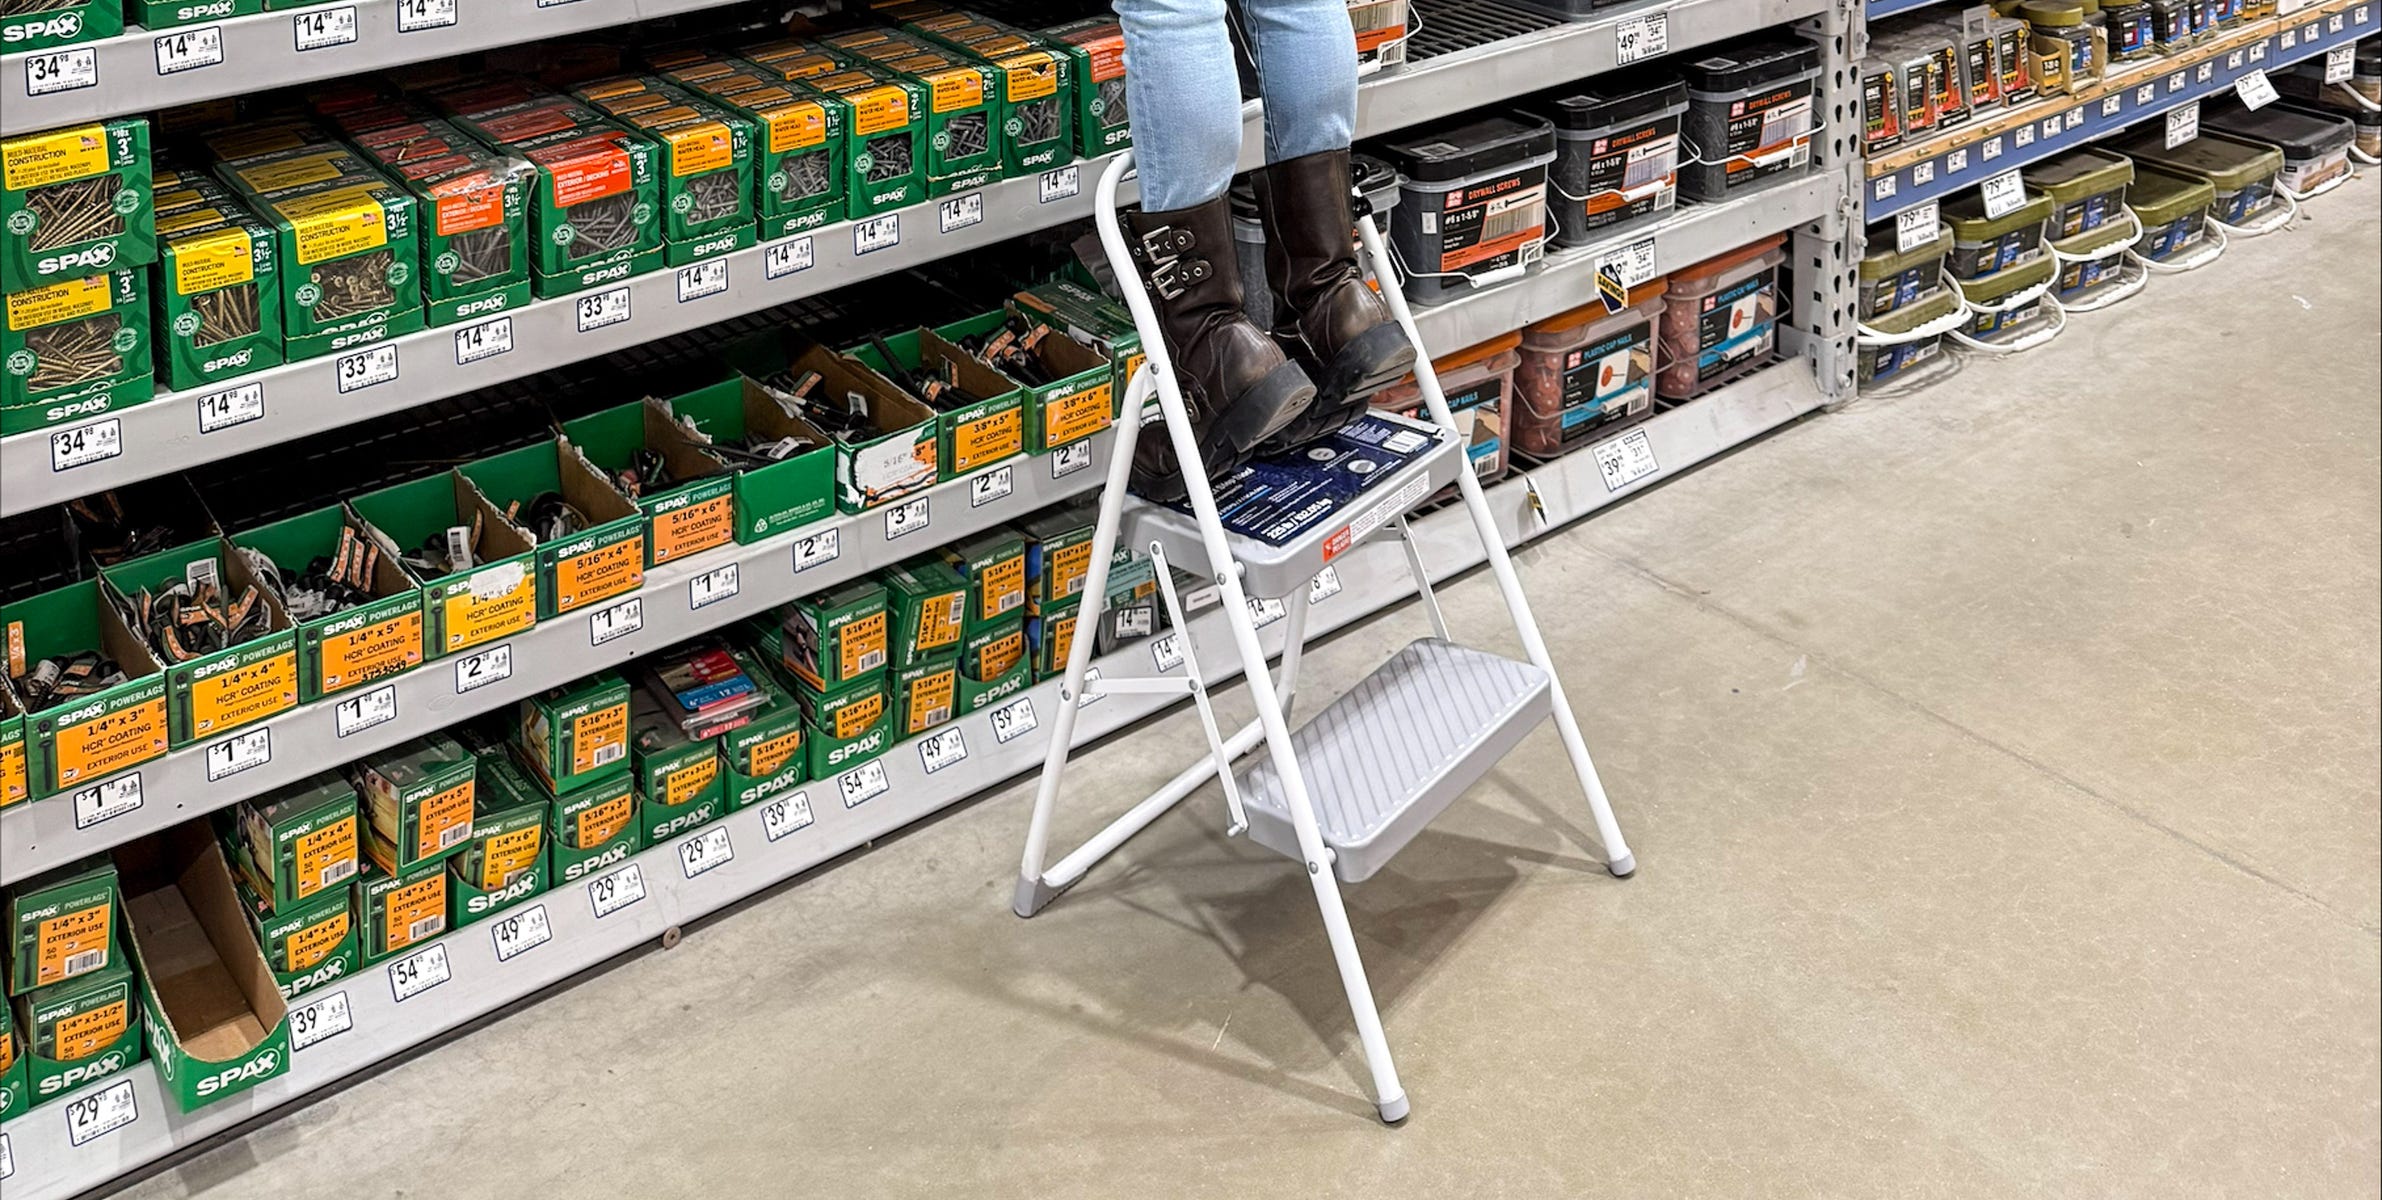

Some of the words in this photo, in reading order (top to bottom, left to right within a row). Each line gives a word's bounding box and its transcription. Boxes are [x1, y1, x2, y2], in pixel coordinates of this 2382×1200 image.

[177, 0, 235, 19] SPAX
[2, 12, 83, 42] SPAX
[8, 149, 66, 166] CONSTRUCTION
[1022, 149, 1055, 167] SPAX
[951, 172, 989, 191] SPAX
[872, 186, 909, 206] SPAX
[784, 209, 827, 232] SPAX
[300, 224, 350, 242] CONSTRUCTION
[693, 234, 738, 256] SPAX
[37, 242, 117, 275] SPAX
[182, 262, 225, 276] CONSTRUCTION
[582, 261, 632, 285] SPAX
[11, 288, 69, 307] CONSTRUCTION
[1598, 275, 1625, 300] SAVINGS
[456, 293, 507, 317] SPAX
[331, 324, 388, 350] SPAX
[203, 349, 253, 372] SPAX
[46, 393, 112, 421] SPAX
[655, 493, 691, 513] SPAX
[558, 537, 596, 558] SPAX
[674, 536, 705, 551] EXTERIOR
[706, 532, 719, 540] USE
[580, 580, 613, 598] EXTERIOR
[614, 576, 628, 587] USE
[323, 613, 366, 635] SPAX
[470, 620, 504, 637] EXTERIOR
[505, 615, 520, 626] USE
[829, 612, 853, 627] SPAX
[193, 652, 240, 680] SPAX
[348, 660, 385, 677] EXTERIOR
[387, 655, 402, 664] USE
[221, 670, 249, 688] 1/4"
[973, 673, 1024, 708] SPAX
[58, 701, 107, 727] SPAX
[220, 700, 258, 722] EXTERIOR
[260, 696, 278, 708] USE
[823, 696, 848, 712] SPAX
[87, 717, 115, 737] 1/4"
[738, 732, 765, 748] SPAX
[828, 729, 884, 764] SPAX
[87, 750, 129, 771] EXTERIOR
[131, 744, 149, 757] USE
[654, 761, 682, 776] SPAX
[740, 766, 800, 804] SPAX
[425, 806, 454, 821] EXTERIOR
[455, 798, 470, 810] USE
[652, 800, 716, 840] SPAX
[303, 841, 334, 859] EXTERIOR
[336, 834, 352, 845] USE
[565, 842, 631, 880] SPAX
[392, 898, 424, 914] EXTERIOR
[426, 890, 442, 902] USE
[468, 870, 539, 914] SPAX
[21, 904, 61, 923] SPAX
[46, 926, 84, 944] EXTERIOR
[85, 922, 104, 932] USE
[294, 939, 327, 957] EXTERIOR
[329, 930, 344, 941] USE
[280, 956, 348, 1000] SPAX
[64, 1026, 102, 1044] EXTERIOR
[105, 1019, 121, 1029] USE
[39, 1050, 126, 1095] SPAX
[196, 1047, 282, 1097] SPAX
